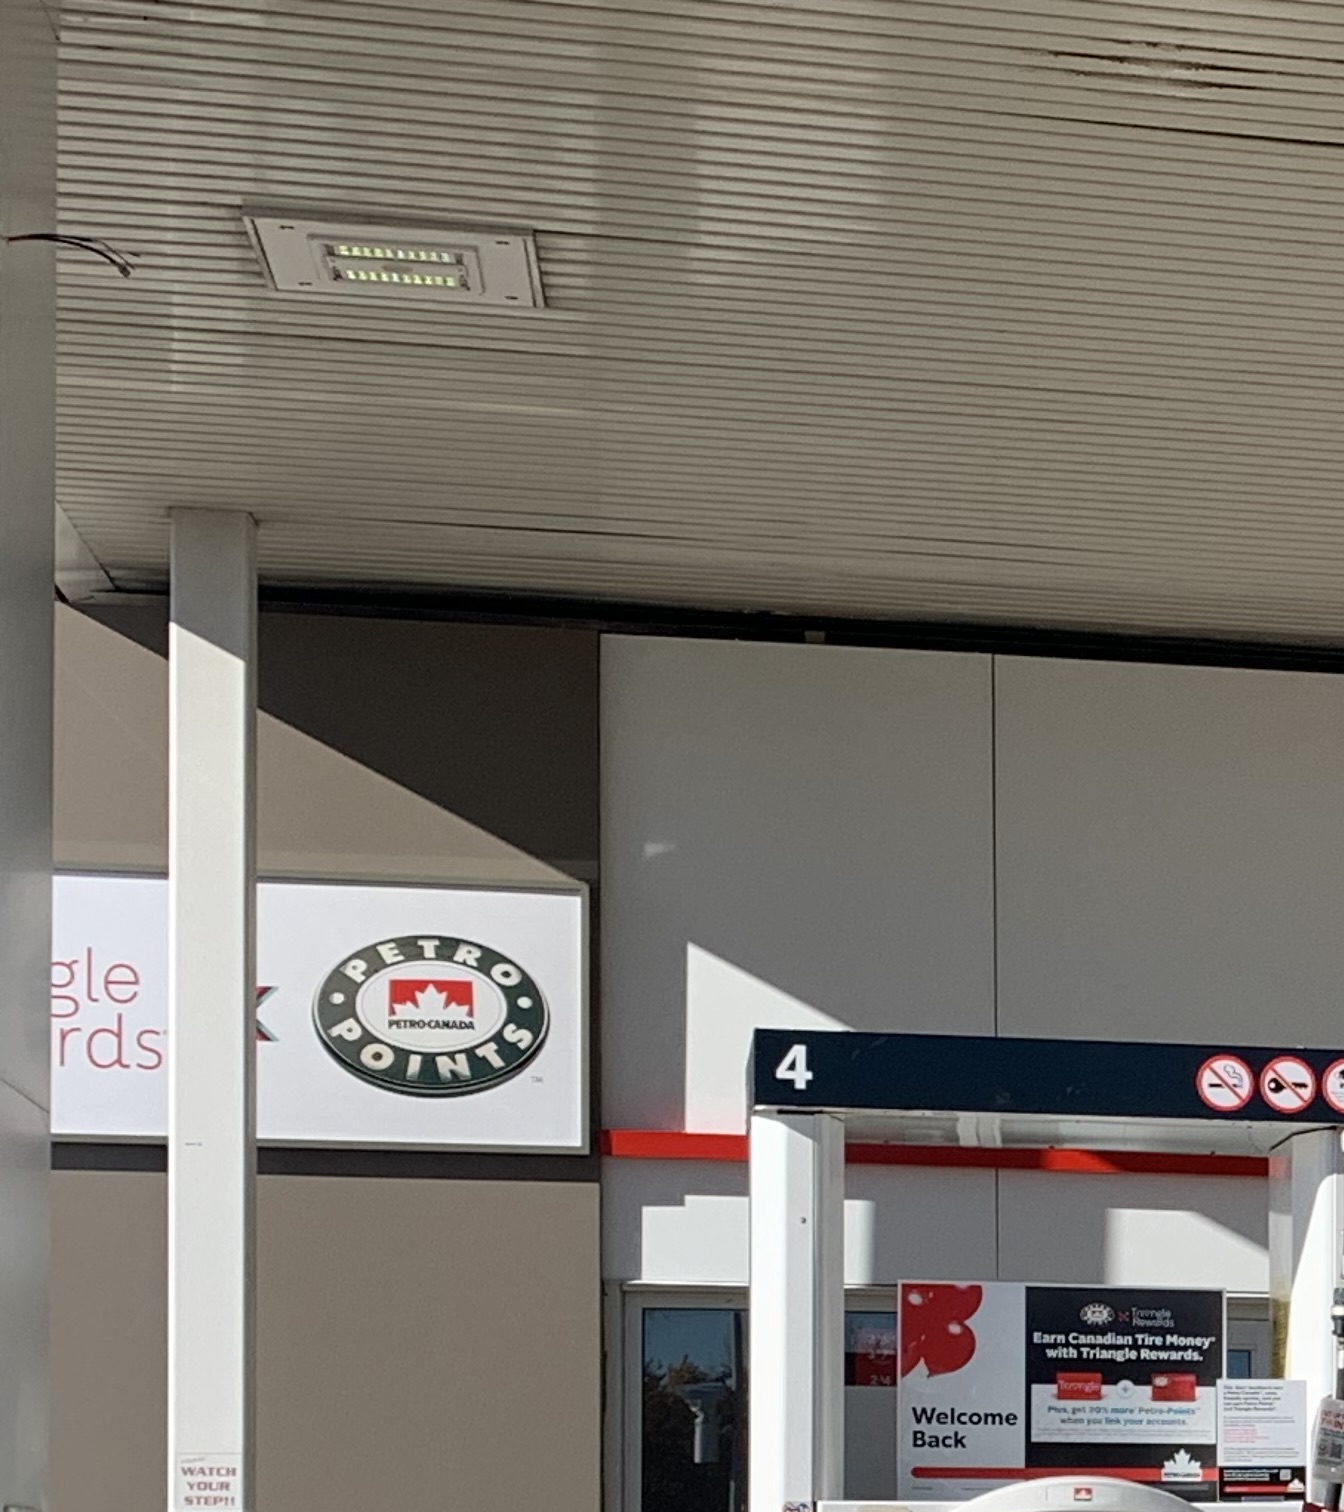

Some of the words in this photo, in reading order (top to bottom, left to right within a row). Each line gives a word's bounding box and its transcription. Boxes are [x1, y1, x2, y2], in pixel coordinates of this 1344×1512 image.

[340, 938, 522, 986] PETRO
[328, 1018, 533, 1082] POINTS
[775, 1044, 813, 1089] 4
[1032, 1331, 1066, 1344] Earn
[1068, 1332, 1133, 1346] Canadian
[1134, 1333, 1163, 1346] Tire
[1045, 1346, 1078, 1359] with
[1079, 1347, 1138, 1362] Triangle
[1140, 1348, 1203, 1362] Rewards.
[911, 1406, 1019, 1426] Welcome
[1104, 1416, 1121, 1425] link
[911, 1431, 967, 1449] Back
[180, 1466, 237, 1478] WATCH
[186, 1481, 231, 1492] YOUR
